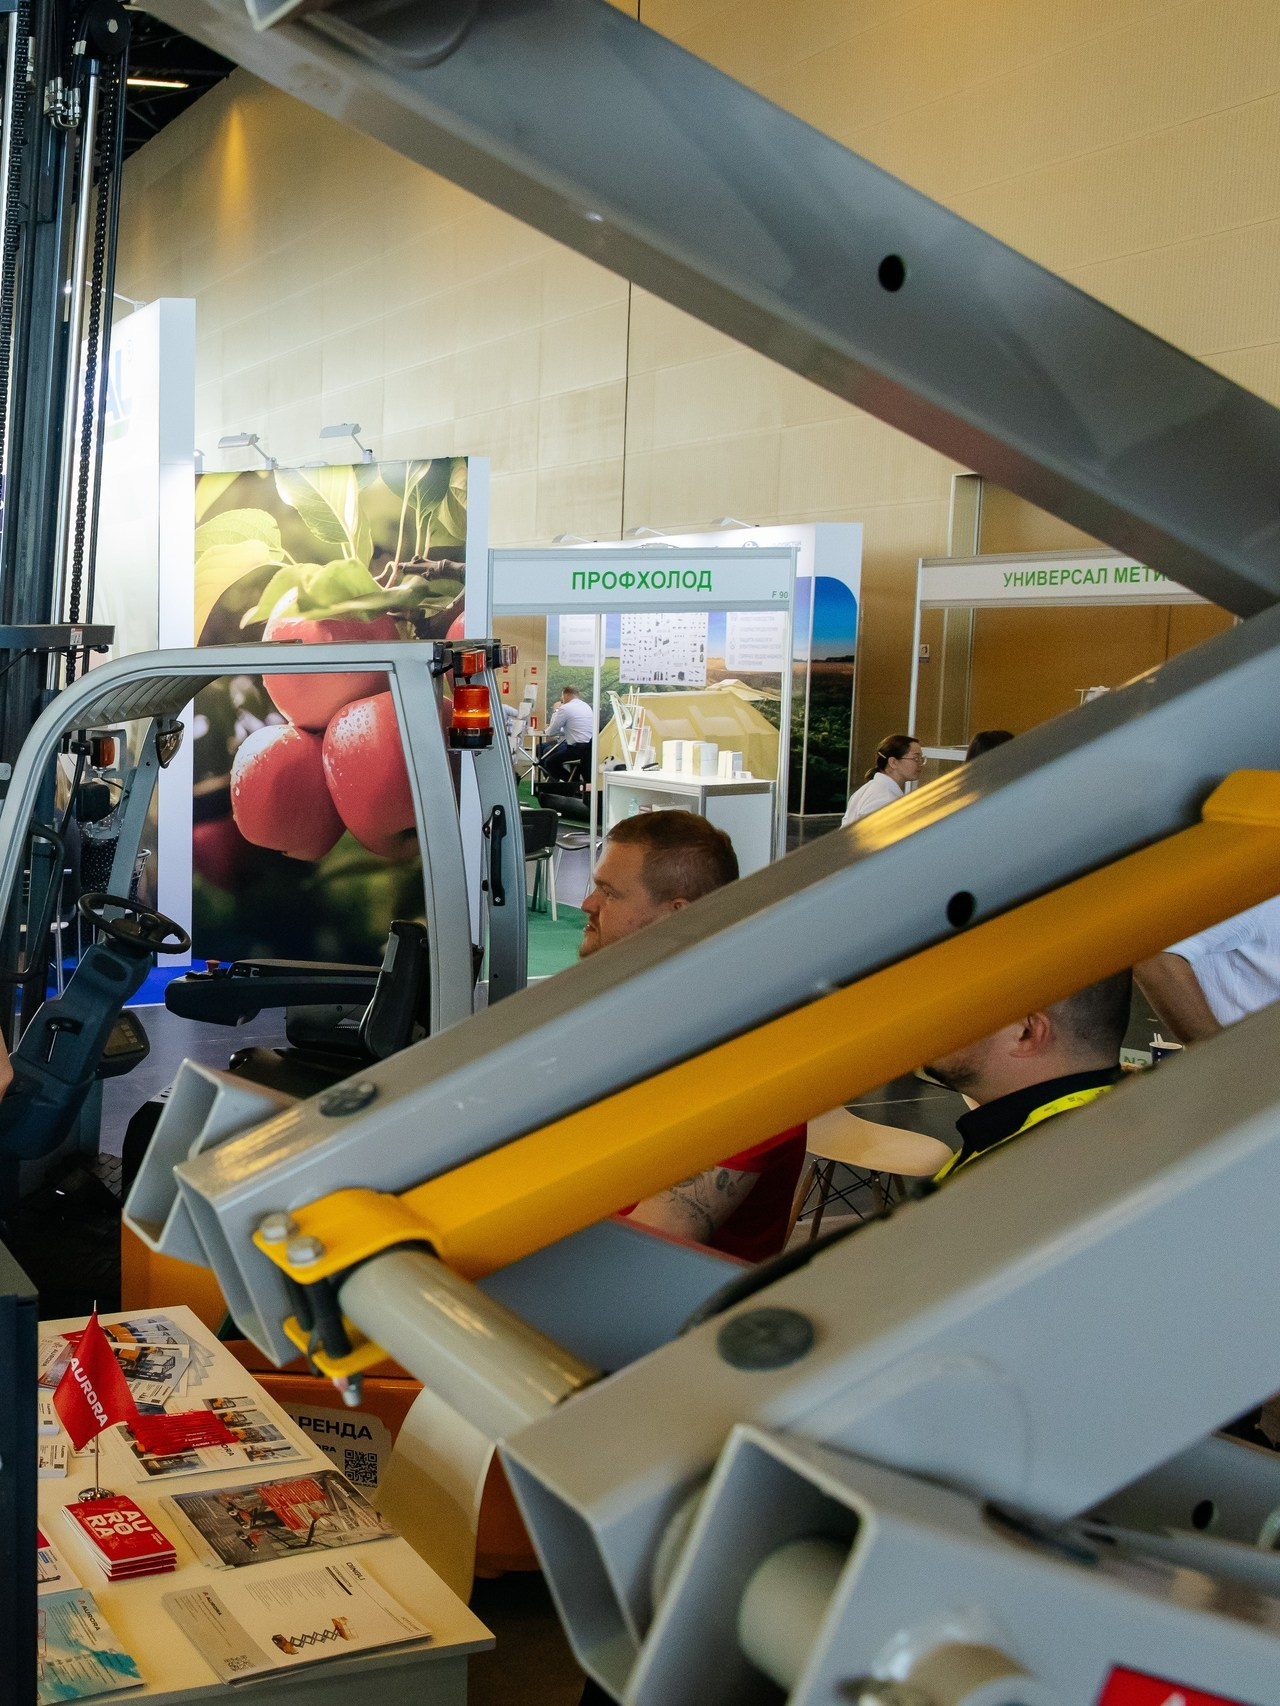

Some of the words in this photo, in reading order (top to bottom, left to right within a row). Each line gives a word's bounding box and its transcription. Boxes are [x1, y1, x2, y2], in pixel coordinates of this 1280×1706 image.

[571, 570, 713, 592] ПРОФХОЛОД
[1003, 567, 1108, 588] УНИВЕРСАЛ
[771, 590, 778, 599] F
[779, 590, 789, 599] 90
[70, 1357, 109, 1428] AURORA
[289, 1414, 373, 1441] РЕНДА
[86, 1514, 116, 1538] RA
[103, 1511, 134, 1535] RO
[120, 1510, 154, 1532] AU
[82, 1605, 101, 1631] AURORA
